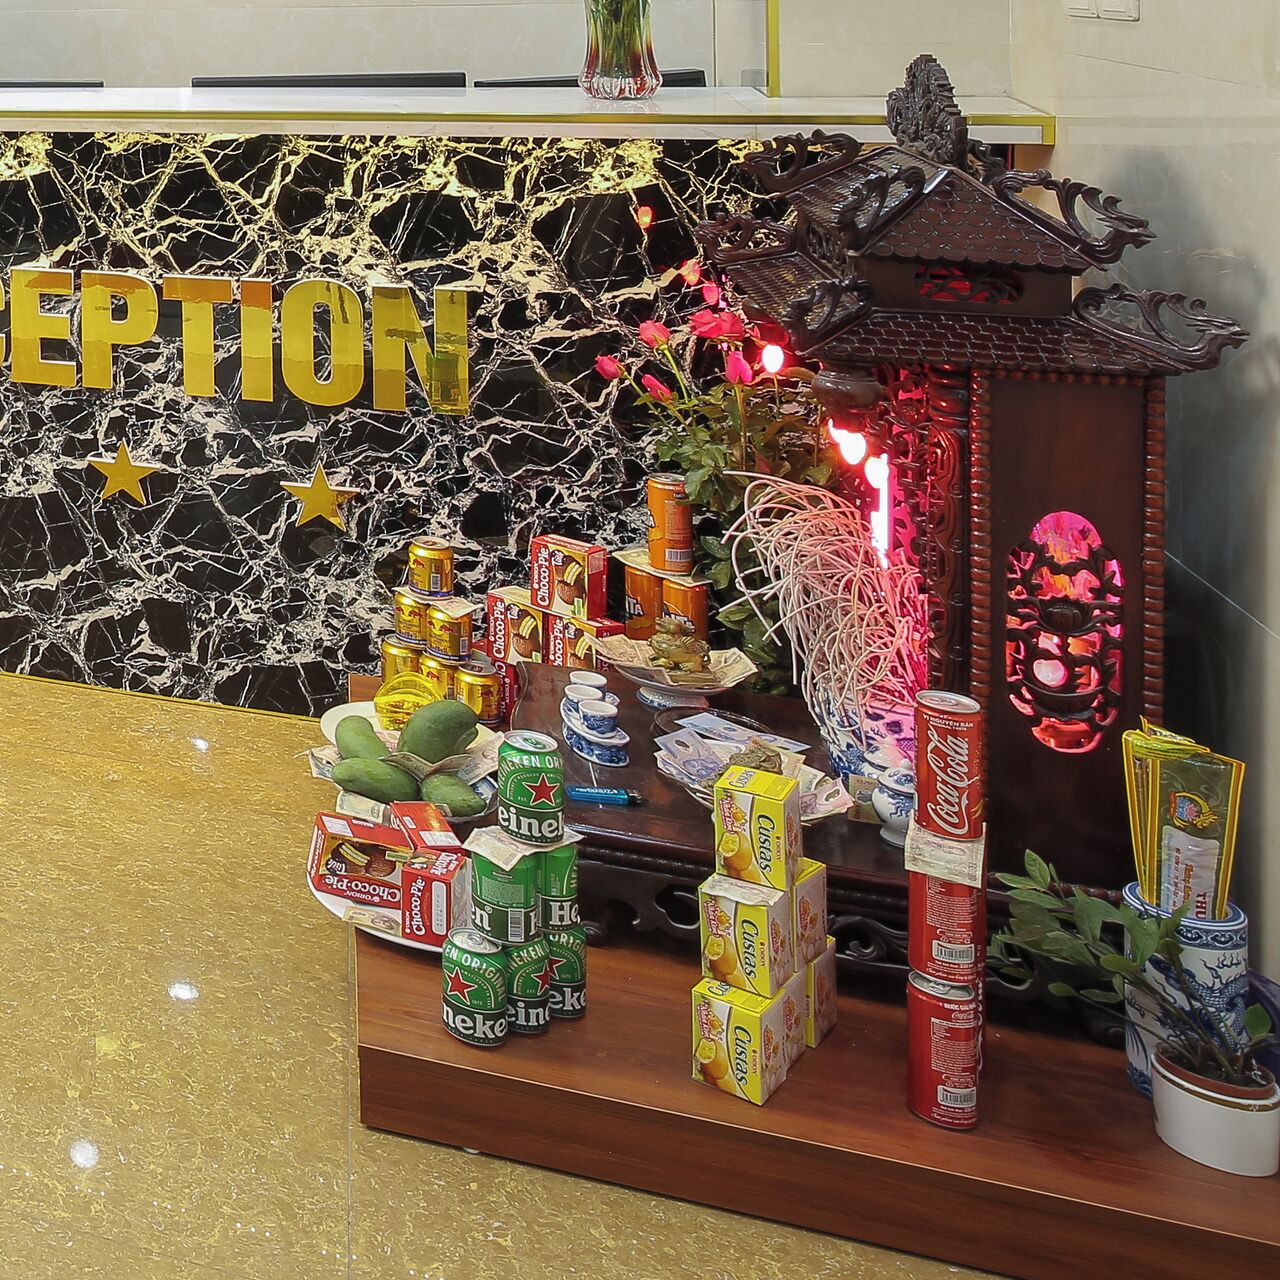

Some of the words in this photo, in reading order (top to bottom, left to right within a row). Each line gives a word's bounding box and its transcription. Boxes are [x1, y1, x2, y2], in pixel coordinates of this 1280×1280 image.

[498, 754, 540, 790] HEINEKEN
[927, 723, 969, 835] Coca-Cola
[757, 814, 776, 873] Custas
[742, 919, 759, 979] Custas
[734, 1025, 752, 1086] Custas
